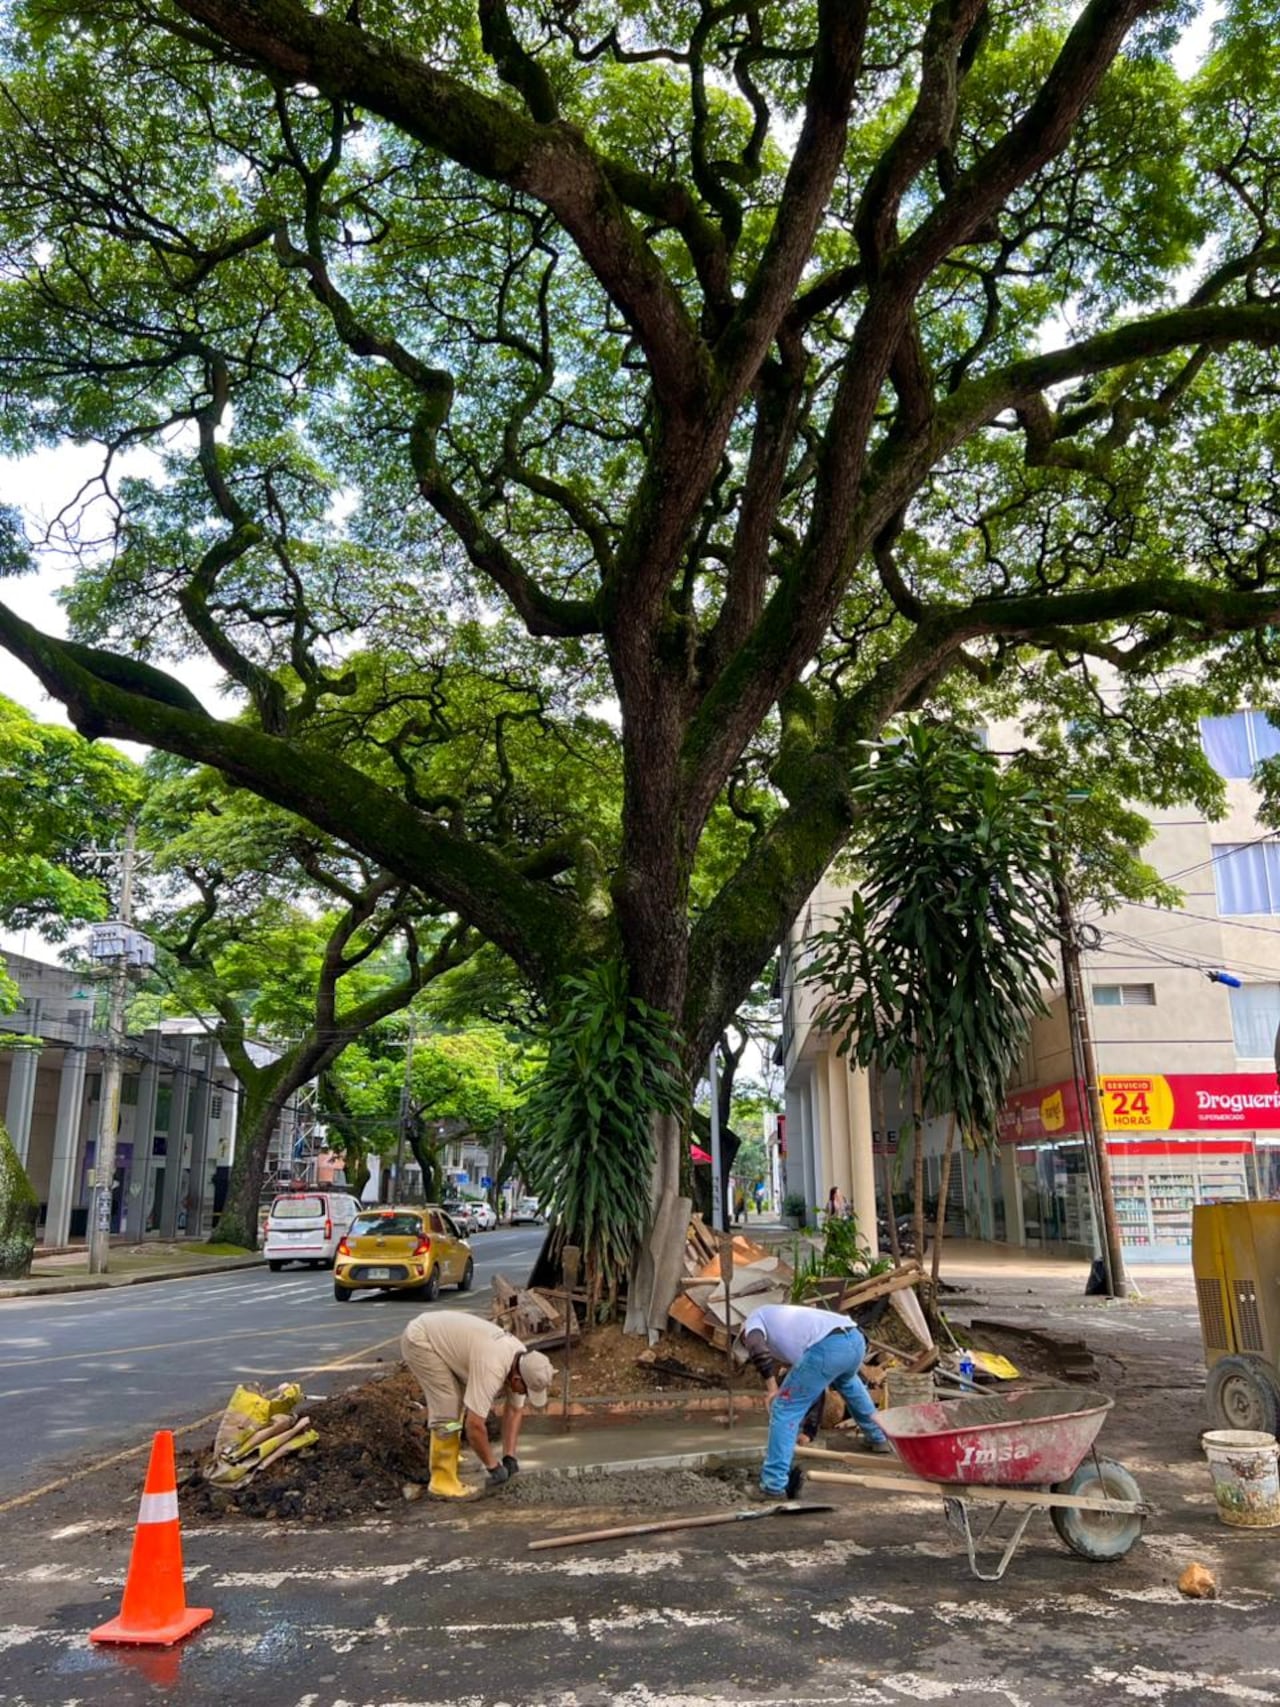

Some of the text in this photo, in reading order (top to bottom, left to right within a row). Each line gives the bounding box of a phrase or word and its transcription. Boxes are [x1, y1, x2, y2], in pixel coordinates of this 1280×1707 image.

[1107, 1082, 1149, 1090] SERVICIO
[1112, 1092, 1150, 1115] 24
[1195, 1090, 1280, 1112] Drogueri
[1114, 1116, 1152, 1125] HORAS
[960, 1445, 1029, 1466] Imsa
